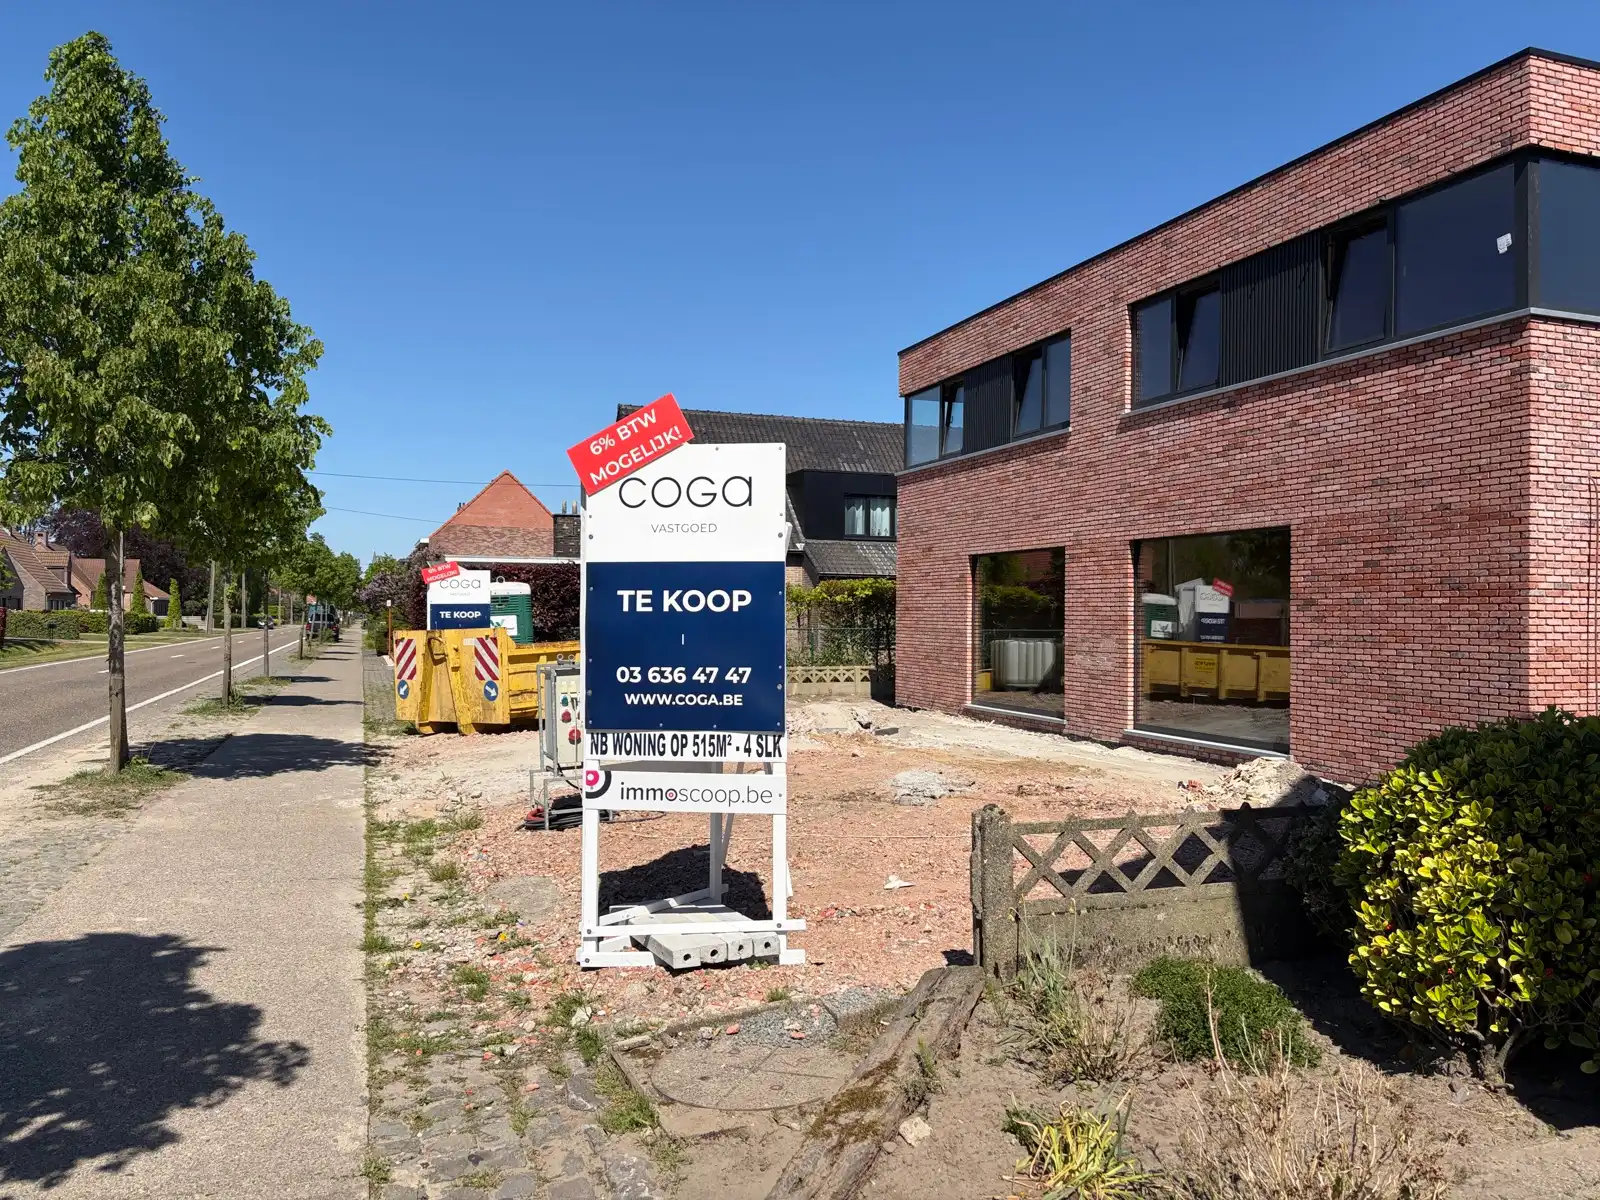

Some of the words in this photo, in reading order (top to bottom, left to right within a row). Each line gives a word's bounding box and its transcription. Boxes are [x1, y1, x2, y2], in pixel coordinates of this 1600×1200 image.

[589, 434, 616, 456] 6%
[616, 408, 657, 441] BTW
[589, 425, 683, 486] MOGELIJK!
[651, 523, 718, 533] VASTGOED
[617, 590, 653, 612] TE
[663, 589, 752, 612] KOOP
[616, 667, 642, 683] 03
[647, 666, 687, 684] 636
[692, 667, 719, 684] 47
[724, 667, 752, 684] 47
[624, 693, 743, 706] WWW.COGA.BE
[590, 732, 608, 756] NB
[612, 733, 666, 757] WONING
[670, 734, 688, 757] OP
[744, 734, 752, 758] 4
[756, 734, 782, 758] SLK
[620, 782, 773, 807] immoscoop.be
